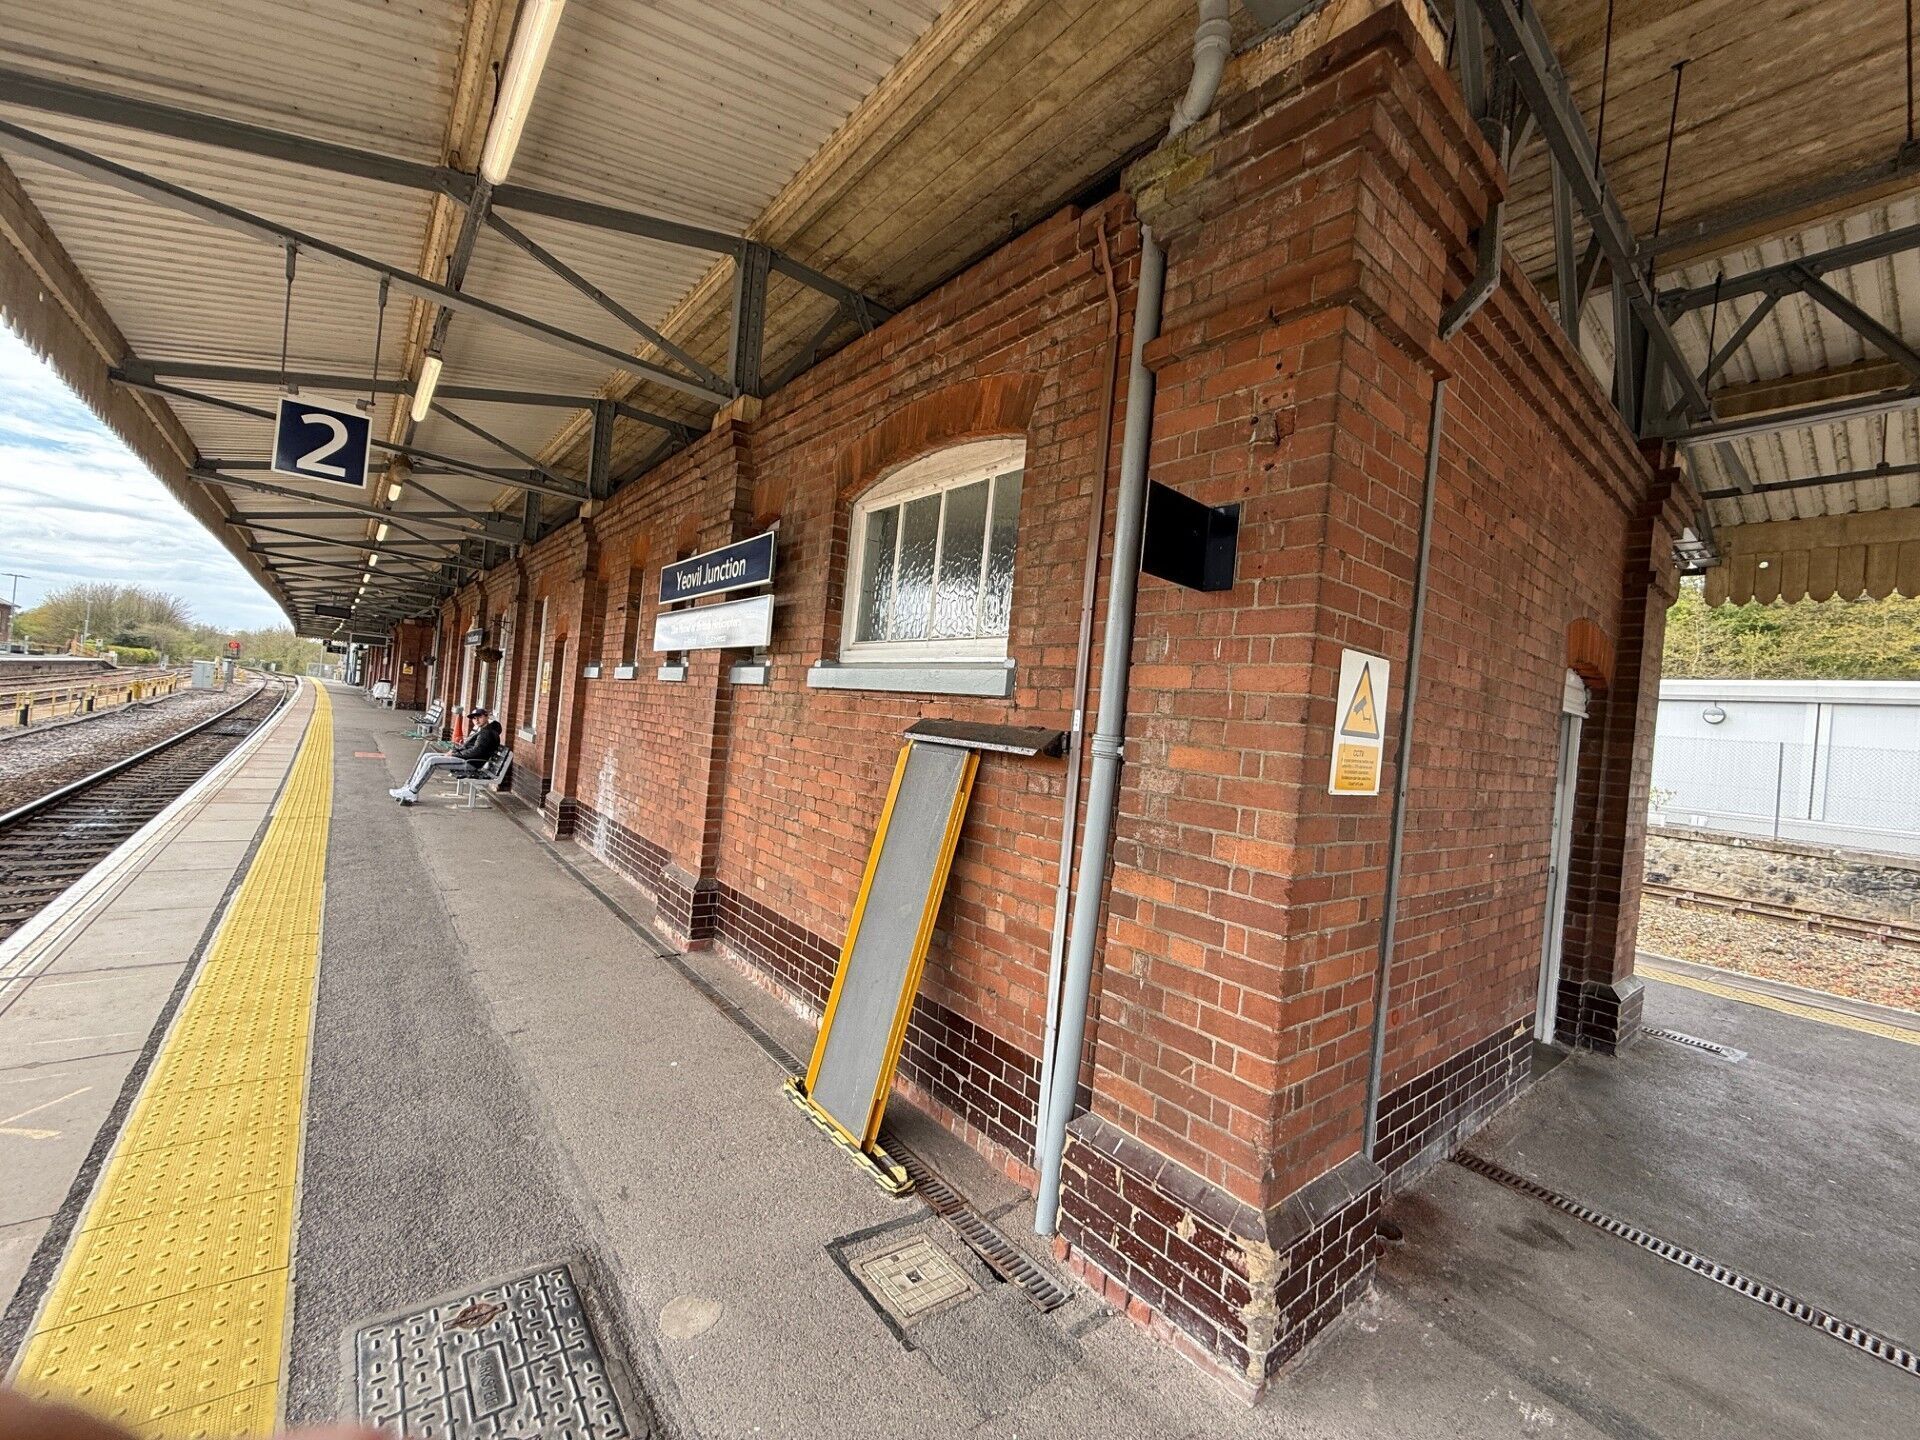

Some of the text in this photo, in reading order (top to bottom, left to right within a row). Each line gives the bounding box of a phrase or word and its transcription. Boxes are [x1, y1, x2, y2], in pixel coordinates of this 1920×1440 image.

[296, 413, 348, 477] 2
[676, 557, 746, 591] Yeovil Junction
